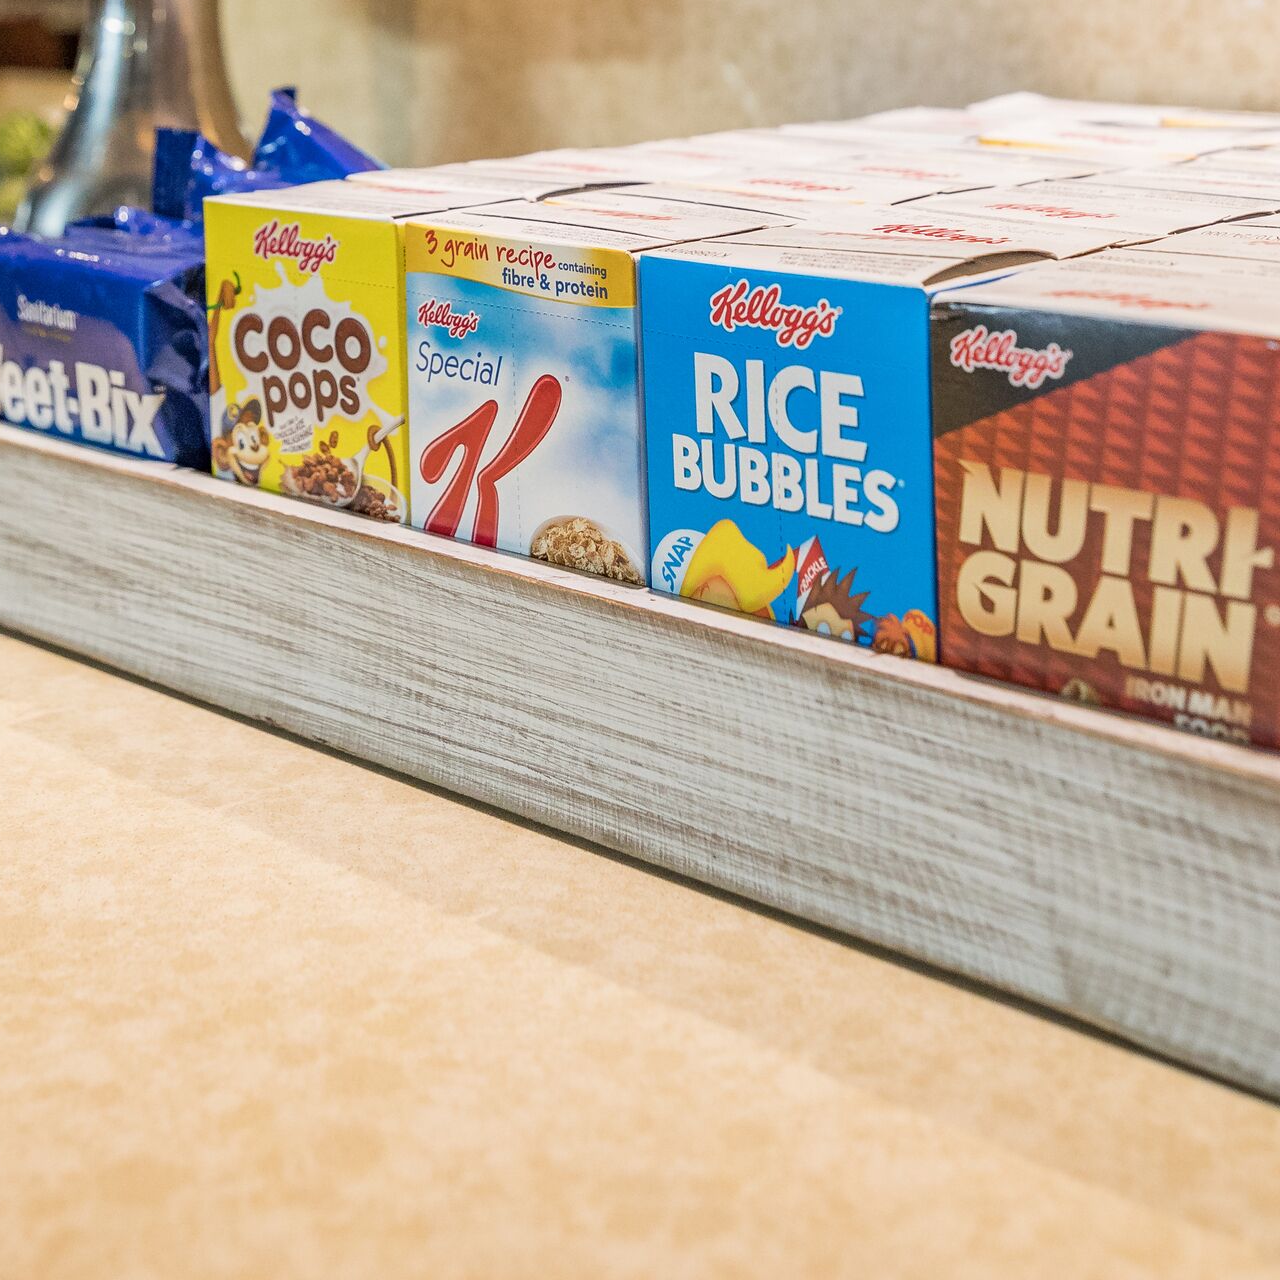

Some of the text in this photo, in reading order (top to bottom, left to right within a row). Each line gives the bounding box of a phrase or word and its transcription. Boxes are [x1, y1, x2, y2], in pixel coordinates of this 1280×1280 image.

[253, 220, 338, 272] Kellogg's
[424, 229, 608, 282] 3 grain recipe containing
[871, 223, 1011, 245] Kellogg's
[502, 267, 609, 300] fibre & protein
[710, 279, 838, 347] Kellogg's
[418, 299, 479, 336] Kellogg's
[416, 341, 504, 387] Special
[951, 325, 1067, 386] Kellogg's
[262, 369, 361, 428] pops
[693, 351, 868, 462] RICE
[419, 373, 563, 549] K
[672, 433, 901, 535] BUBBLES
[956, 459, 1275, 600] NUTRI-
[661, 534, 694, 591] SNAP
[956, 551, 1257, 693] GRAIN
